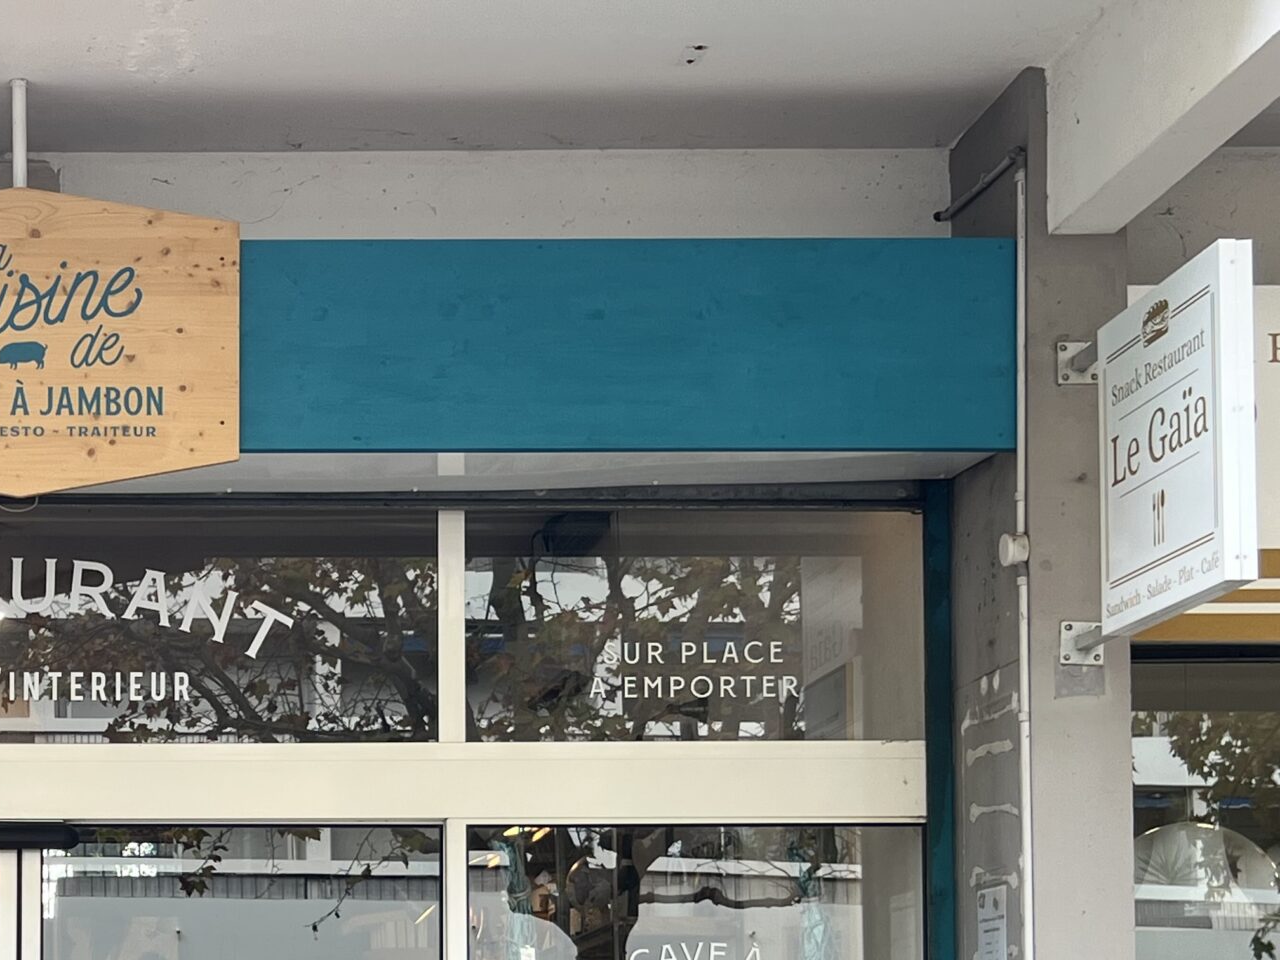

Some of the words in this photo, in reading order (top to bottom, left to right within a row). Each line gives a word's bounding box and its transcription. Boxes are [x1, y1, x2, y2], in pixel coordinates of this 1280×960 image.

[70, 325, 124, 369] de
[1112, 367, 1142, 407] Snack
[1144, 329, 1205, 385] Restaurant
[10, 379, 30, 416] À
[40, 386, 164, 416] JAMBON
[67, 426, 157, 437] TRAITEUR
[1111, 434, 1140, 487] Le
[1148, 386, 1209, 463] Gaïa
[1178, 565, 1194, 585] Plat
[603, 642, 664, 664] SUR
[681, 641, 784, 664] PLACE
[624, 675, 799, 698] EMPORTER
